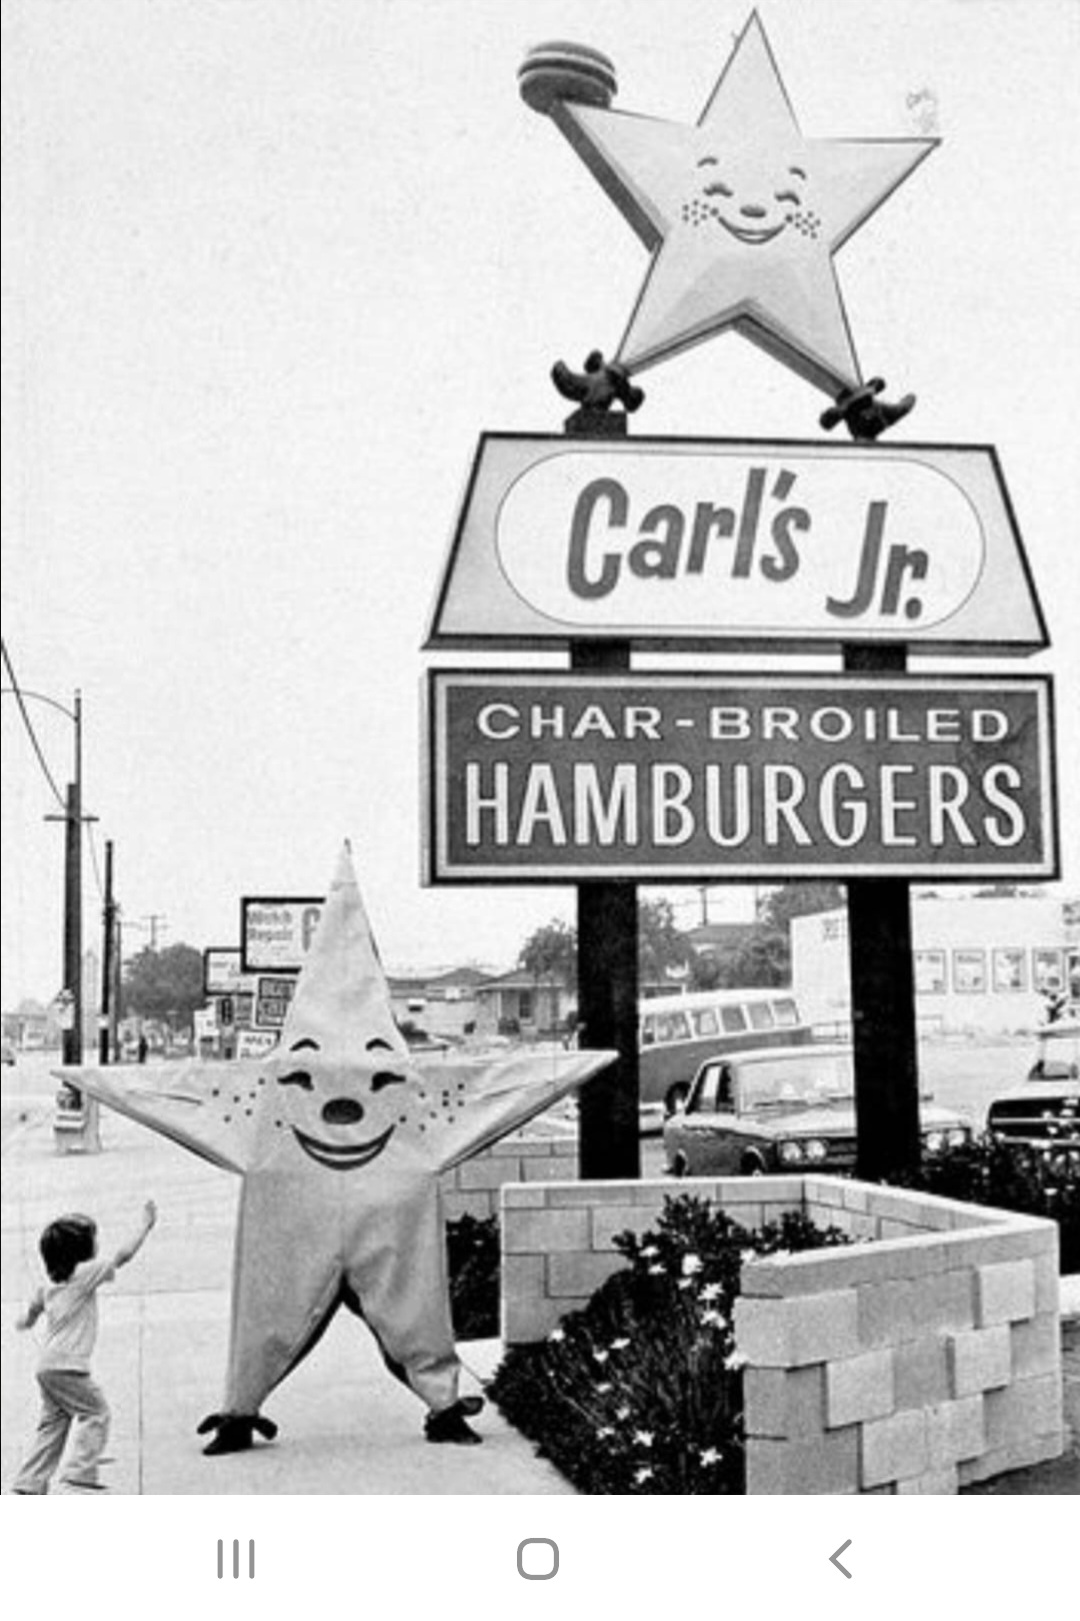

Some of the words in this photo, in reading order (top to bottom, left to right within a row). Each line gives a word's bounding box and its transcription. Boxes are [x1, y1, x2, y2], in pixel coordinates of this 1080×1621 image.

[567, 467, 812, 601] Carl's
[825, 500, 930, 620] Jr.
[477, 703, 1010, 742] CHAR-BROILED
[465, 761, 1026, 847] HAMBURGERS
